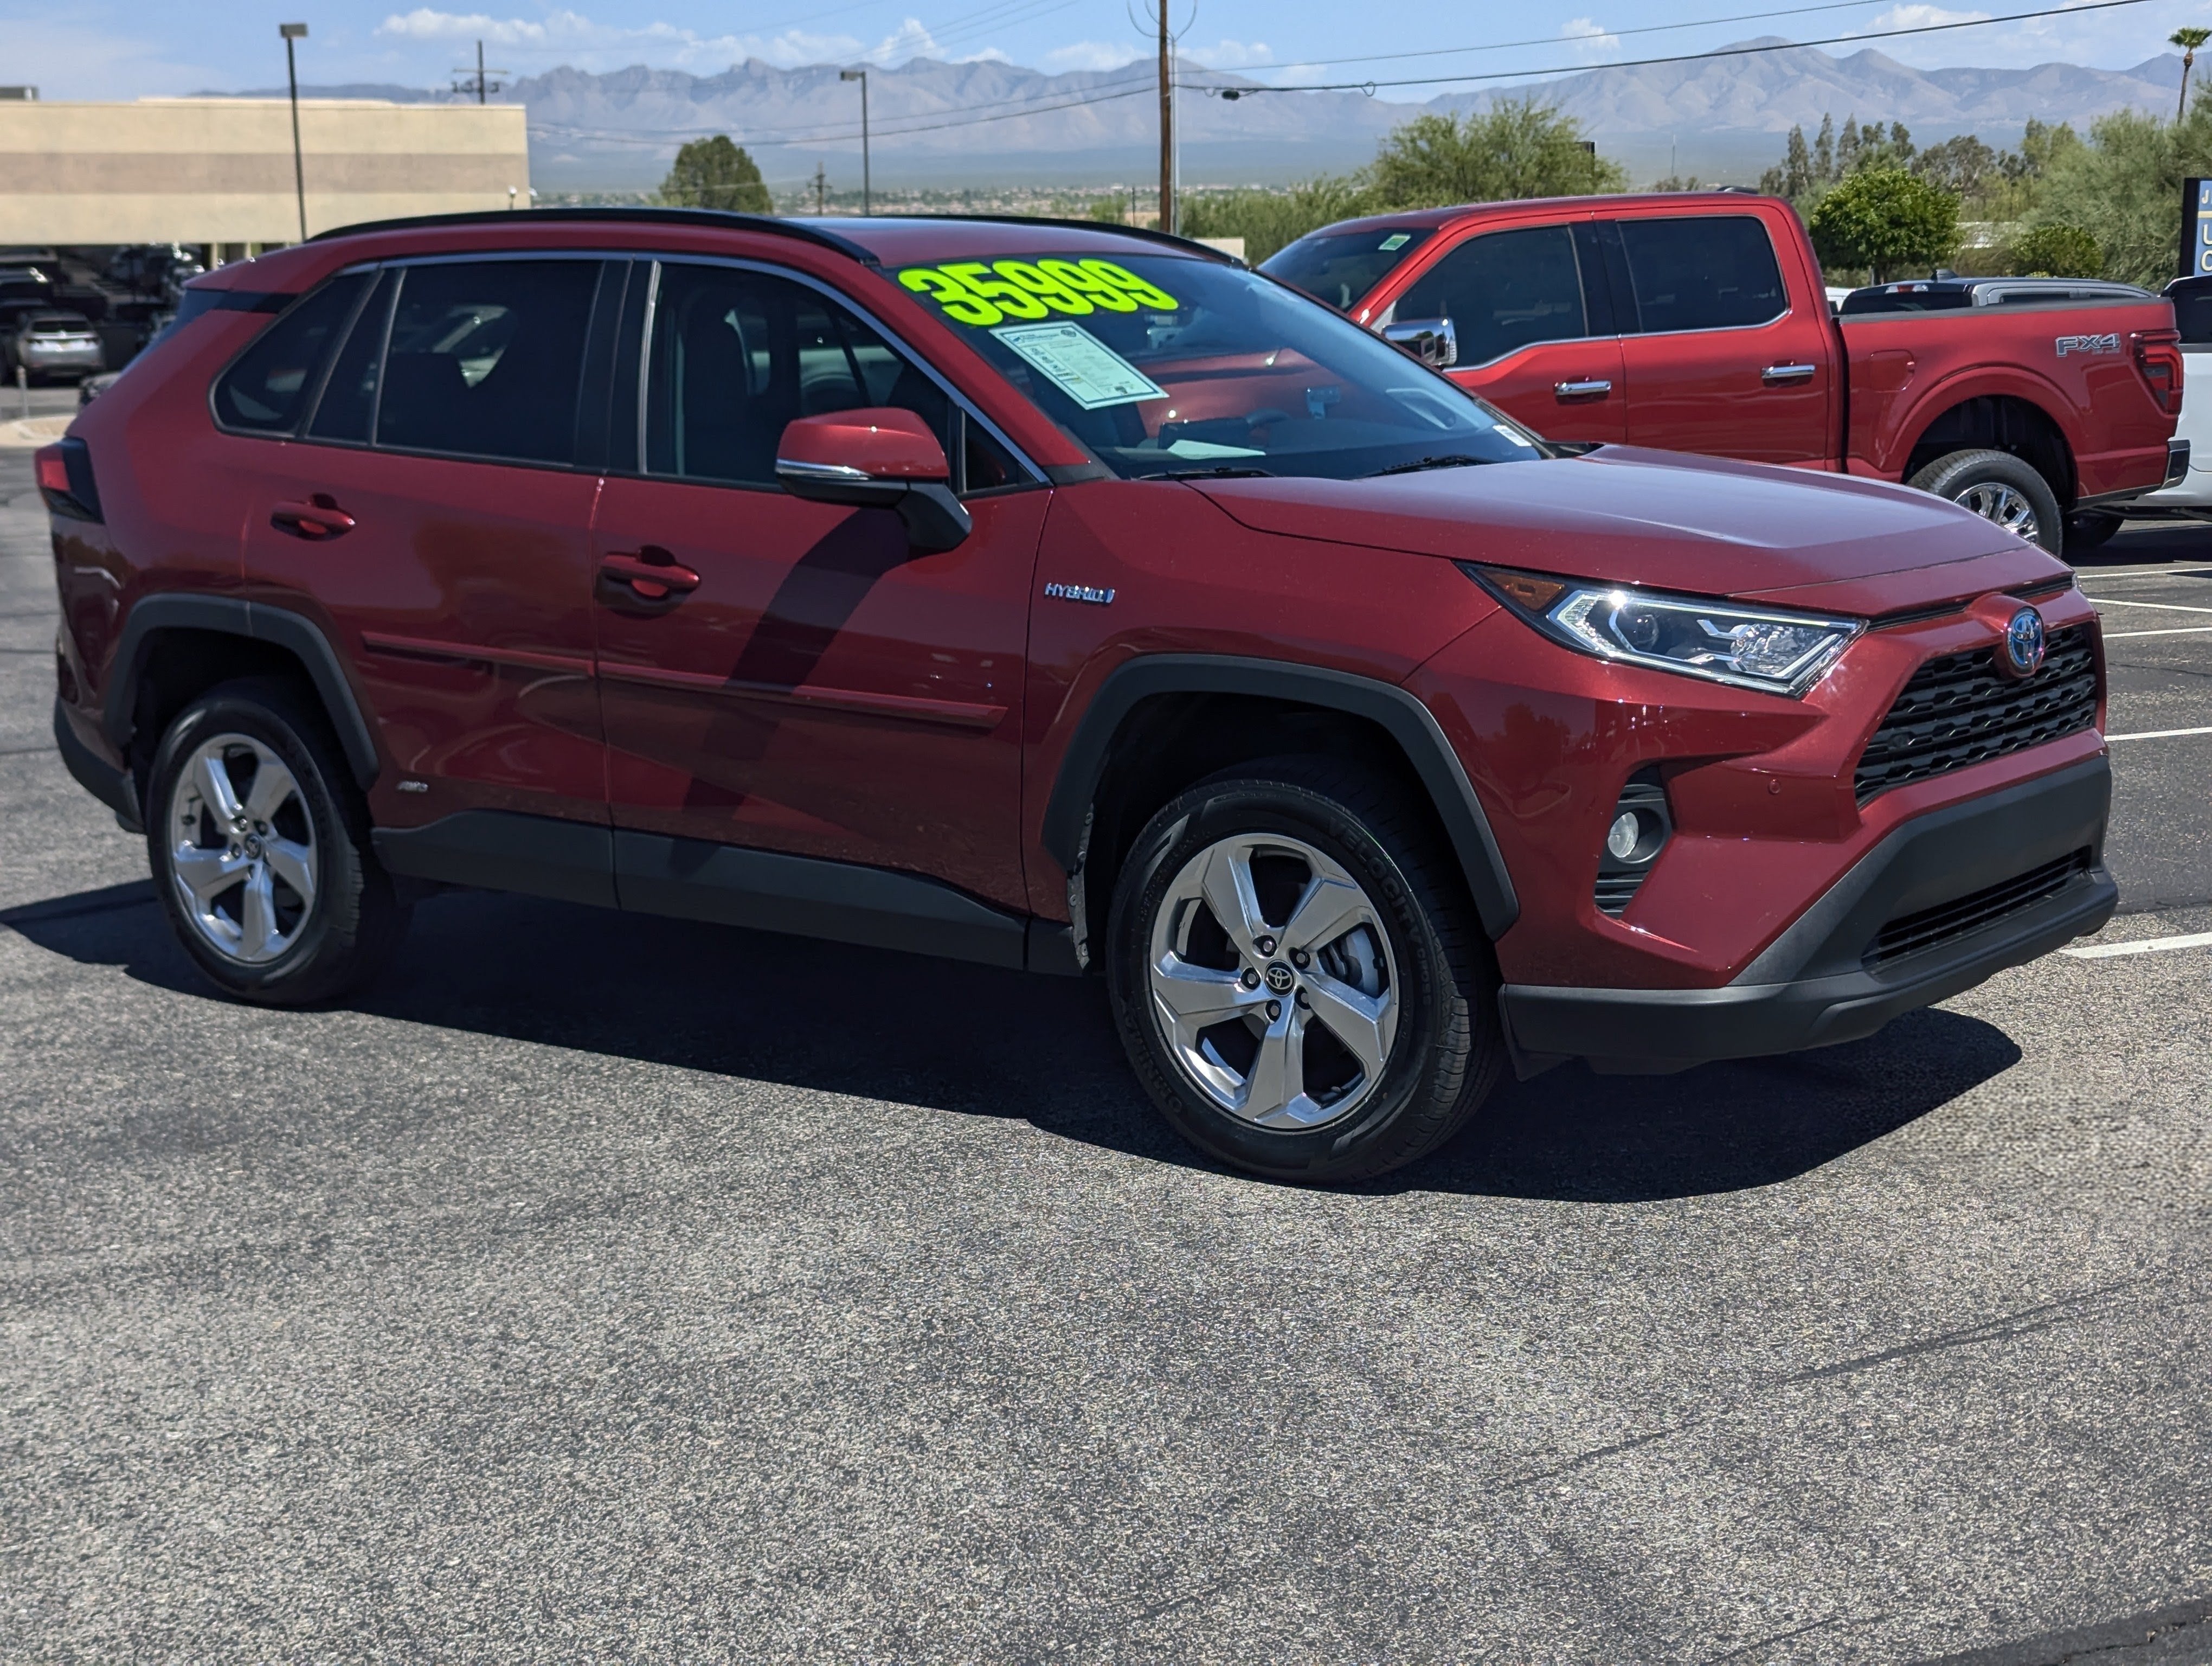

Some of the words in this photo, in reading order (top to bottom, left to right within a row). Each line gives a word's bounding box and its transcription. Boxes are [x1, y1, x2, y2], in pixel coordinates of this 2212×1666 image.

[898, 258, 1178, 325] 35999
[2055, 334, 2120, 357] FX4
[1045, 582, 1103, 602] HYBRID
[1328, 815, 1423, 946] VELOCITY
